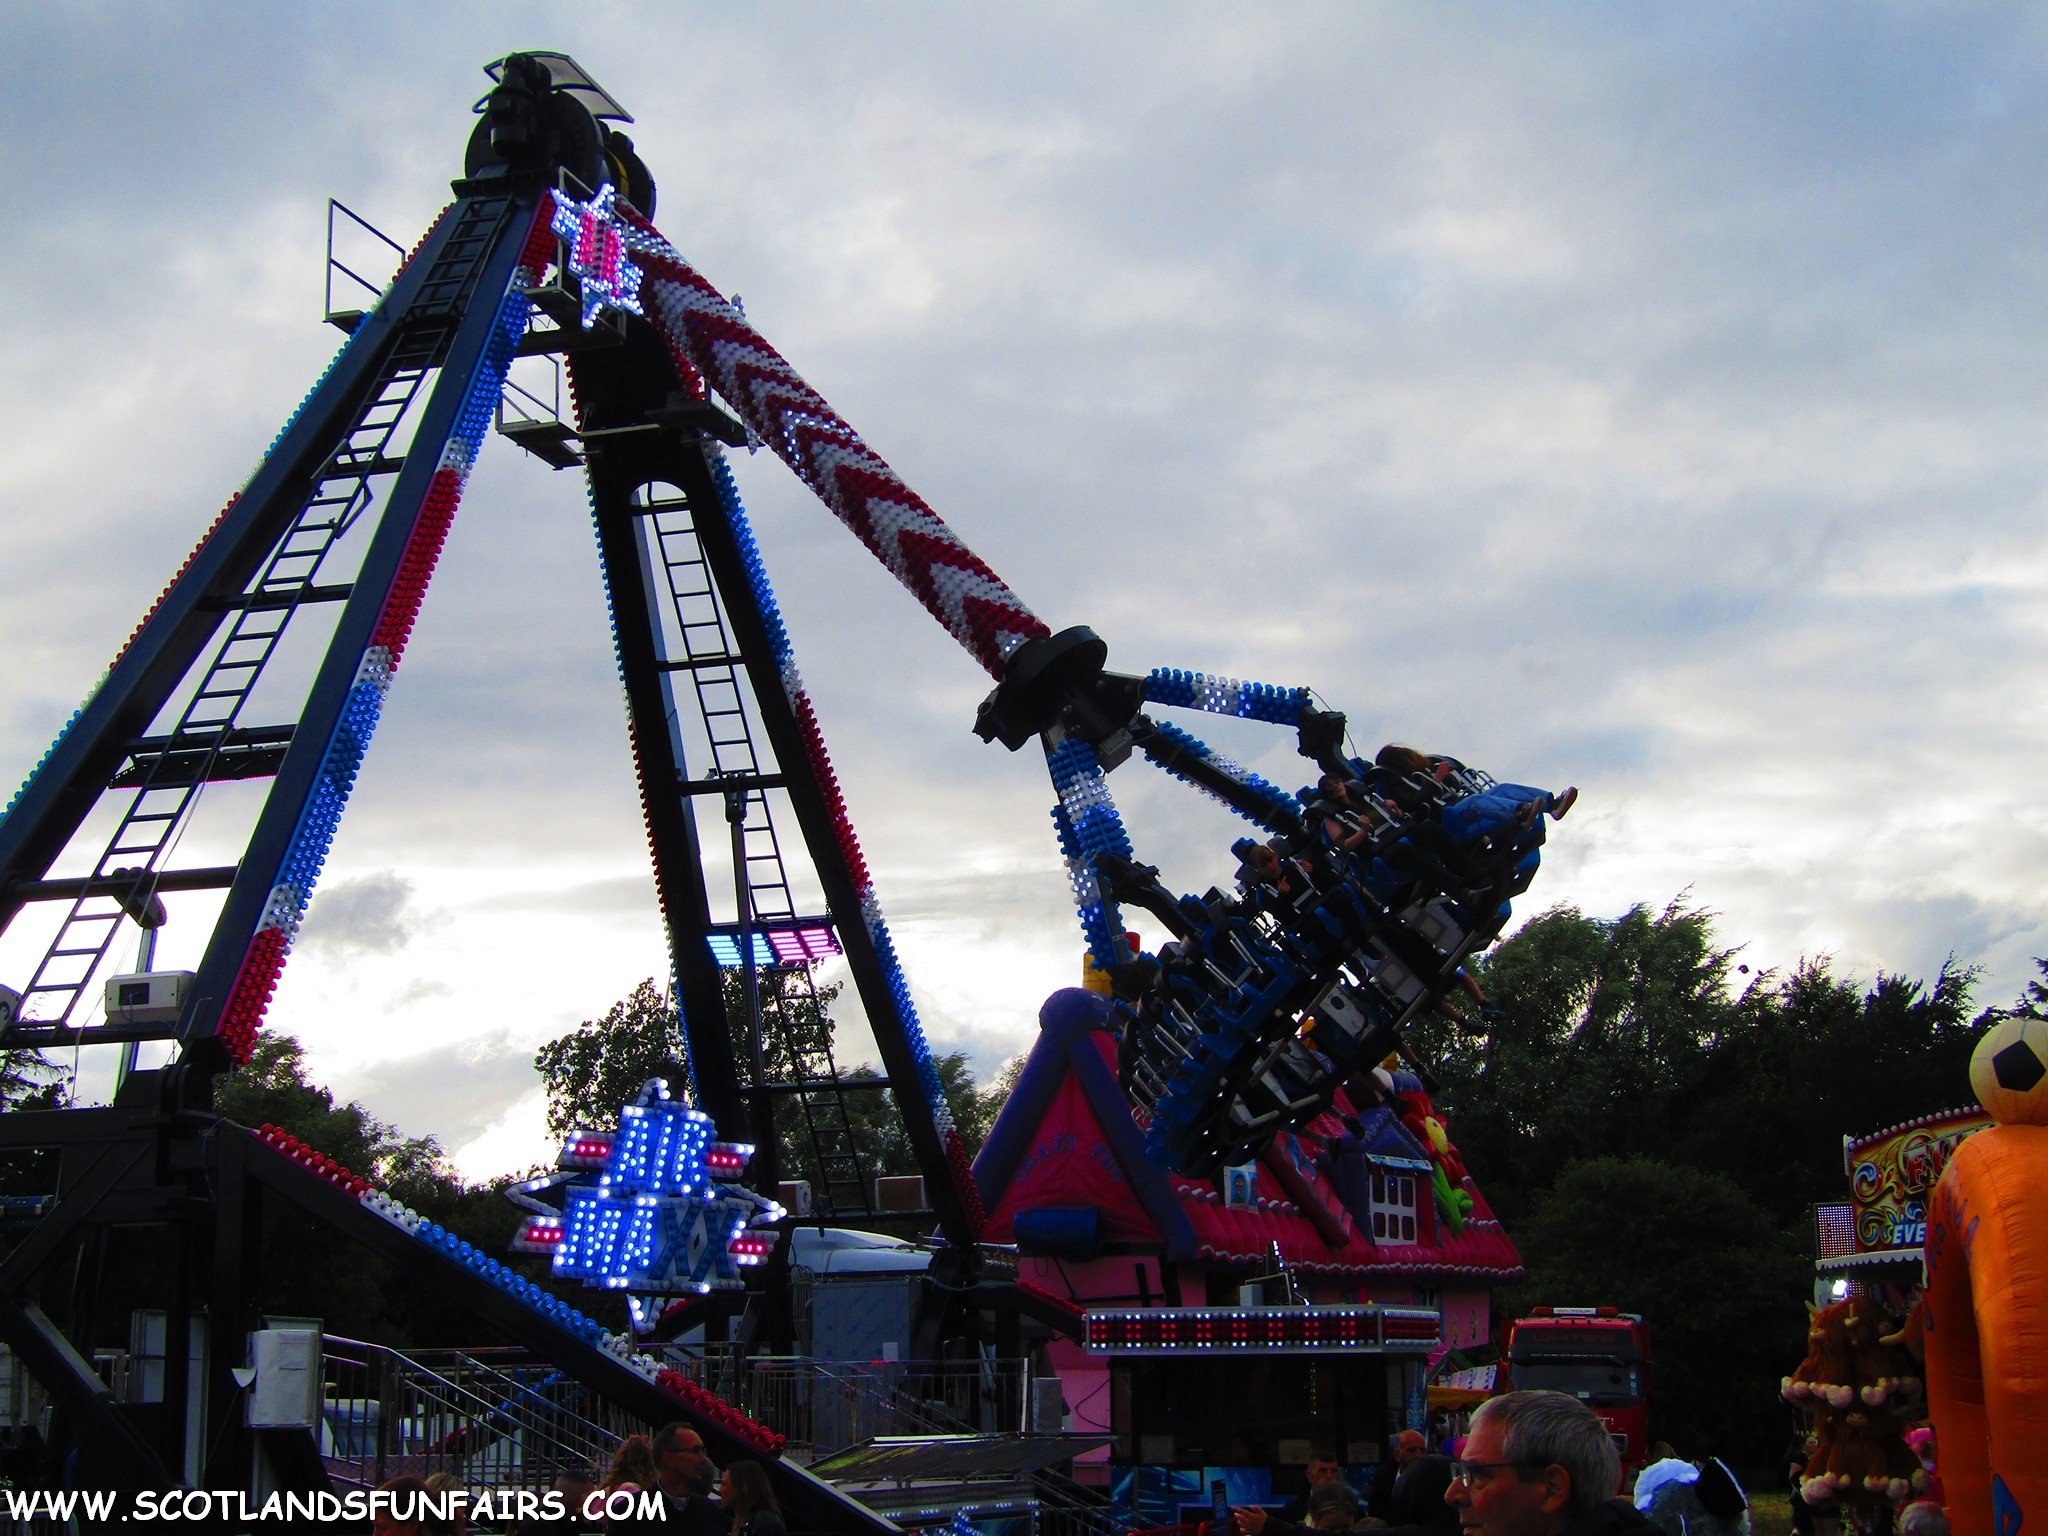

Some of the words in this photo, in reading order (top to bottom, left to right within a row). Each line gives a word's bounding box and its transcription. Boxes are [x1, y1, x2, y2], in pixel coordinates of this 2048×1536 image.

[610, 1113, 709, 1192] AIR
[1904, 1121, 1994, 1191] FU
[561, 1197, 742, 1282] MAXX
